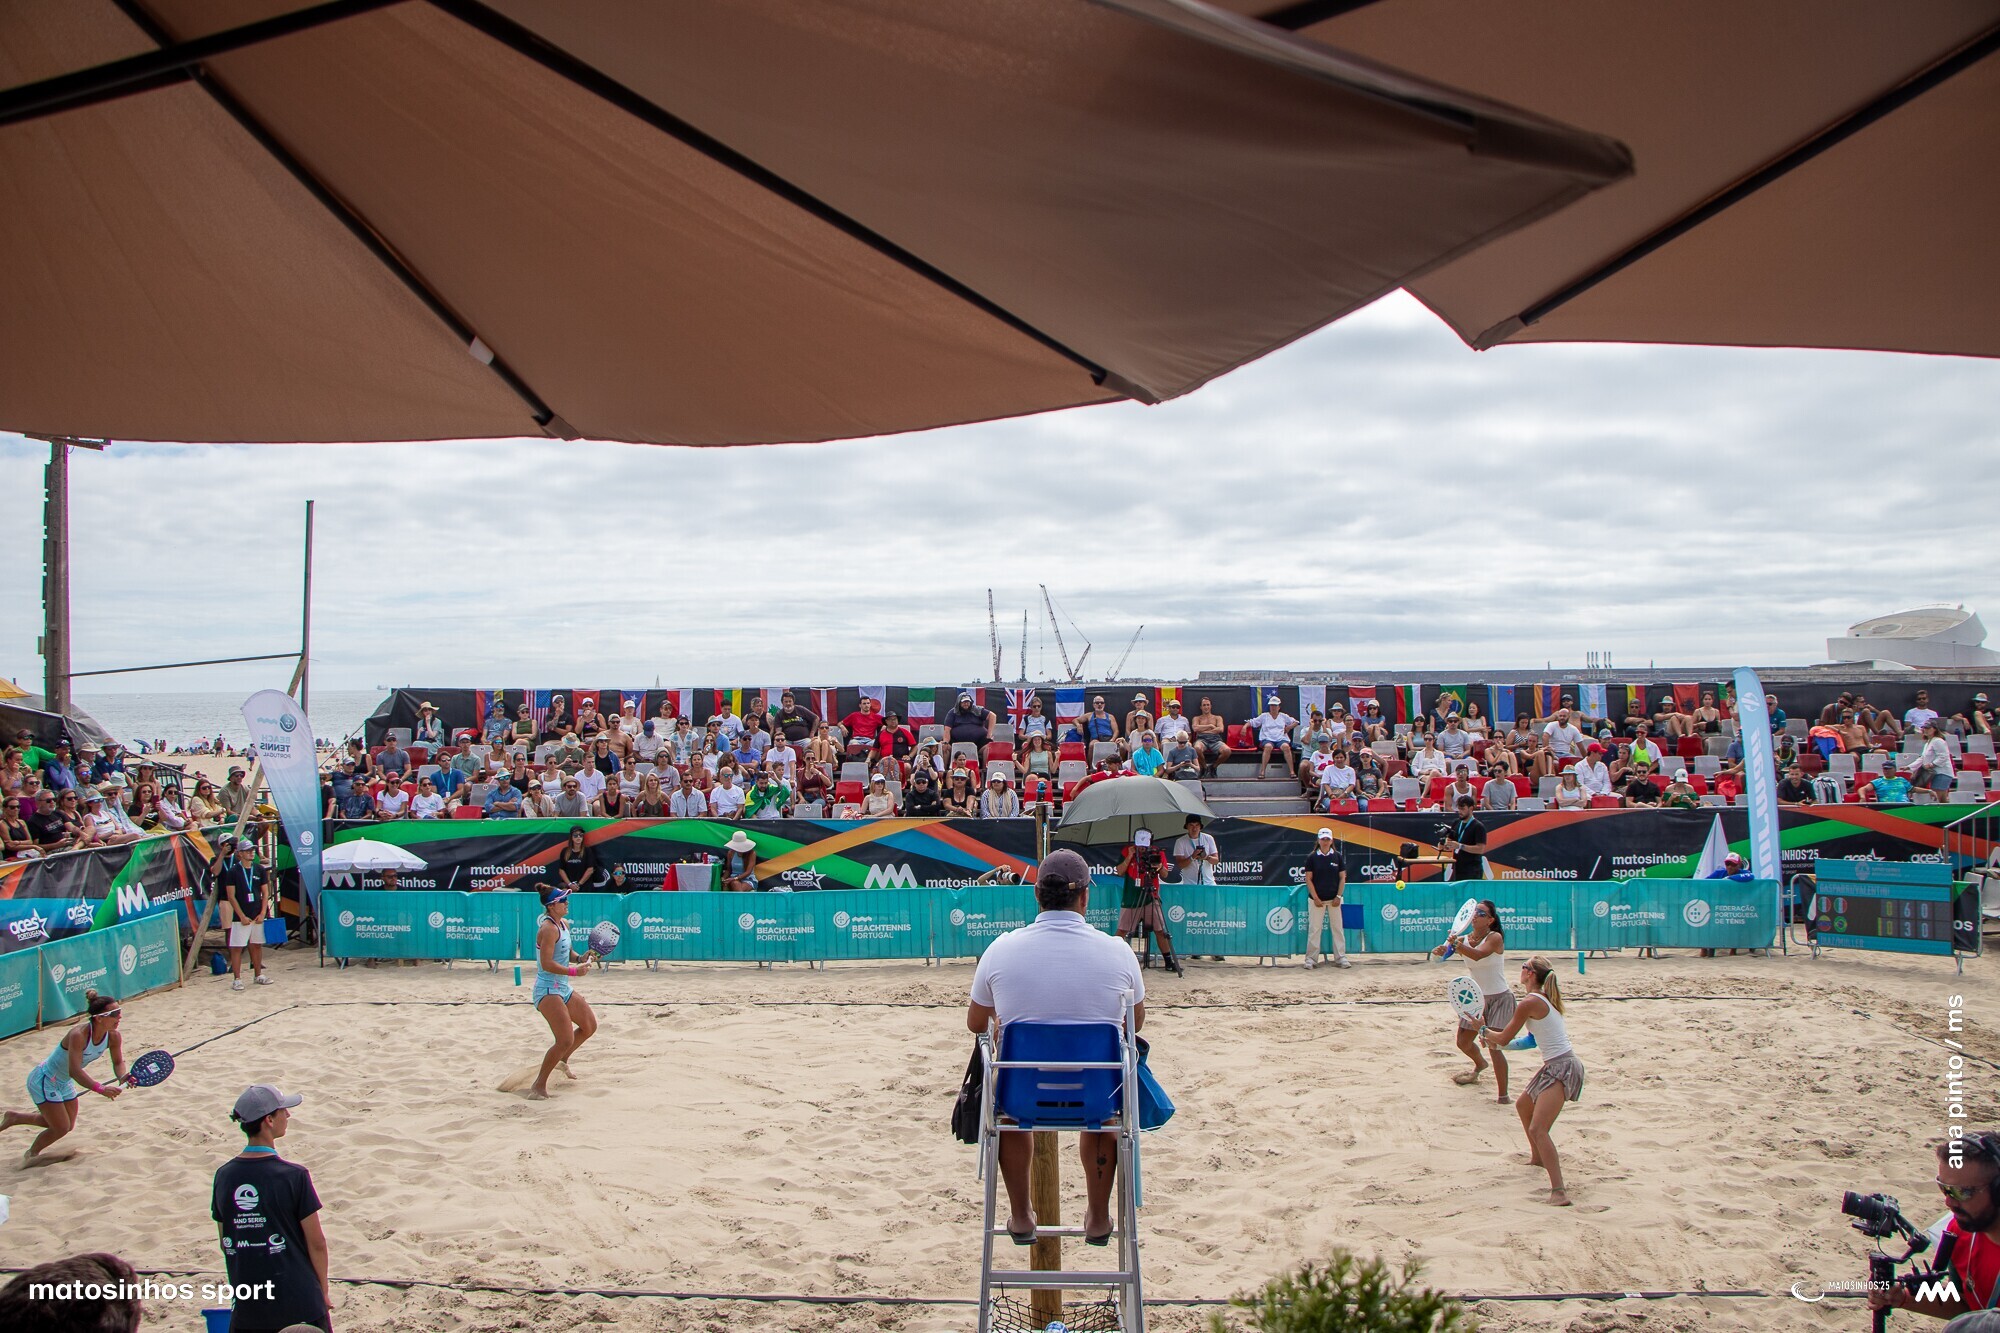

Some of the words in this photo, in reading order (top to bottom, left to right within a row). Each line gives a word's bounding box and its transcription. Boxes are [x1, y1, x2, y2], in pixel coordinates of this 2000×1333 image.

[1612, 853, 1687, 865] matosinhos
[1782, 848, 1819, 861] INHOS'25
[1911, 853, 1939, 863] aces
[470, 864, 547, 876] matosinhos
[623, 862, 670, 874] ATOSINHOS
[1361, 865, 1393, 876] aces
[1501, 868, 1578, 879] matosinhos
[1612, 867, 1647, 879] sport
[781, 870, 814, 881] aces
[363, 877, 437, 888] masinhos
[470, 877, 506, 890] sport
[153, 886, 193, 907] matosinhos
[1715, 904, 1755, 912] FEDERAÇÃO
[1886, 901, 1893, 916] 0
[1904, 902, 1911, 918] 6
[1921, 903, 1928, 919] 0
[1400, 917, 1454, 925] BEACHTENNI
[1611, 911, 1665, 920] BEACHTENNIS
[9, 916, 40, 935] aces
[852, 923, 911, 932] BEACHTENNIS
[967, 921, 1026, 930] BEACHTENNIS
[1186, 920, 1246, 928] BEACHTENNIS
[1611, 919, 1651, 927] PORTUGAL
[446, 925, 500, 934] BEACHTENNIS
[644, 925, 701, 934] BEACHTENNIS
[756, 926, 815, 935] BEACHTENNIS
[1886, 920, 1893, 935] 0
[1904, 921, 1911, 937] 3
[1921, 922, 1928, 938] 0
[446, 933, 483, 941] PORTUGAL
[644, 933, 684, 941] PORTUGAL
[756, 934, 797, 942] PORTUGAL
[140, 946, 169, 960] PORTUGUESA
[140, 959, 148, 967] DE
[66, 967, 108, 986] BEACHTENNIS
[65, 979, 98, 994] PORTUGAL
